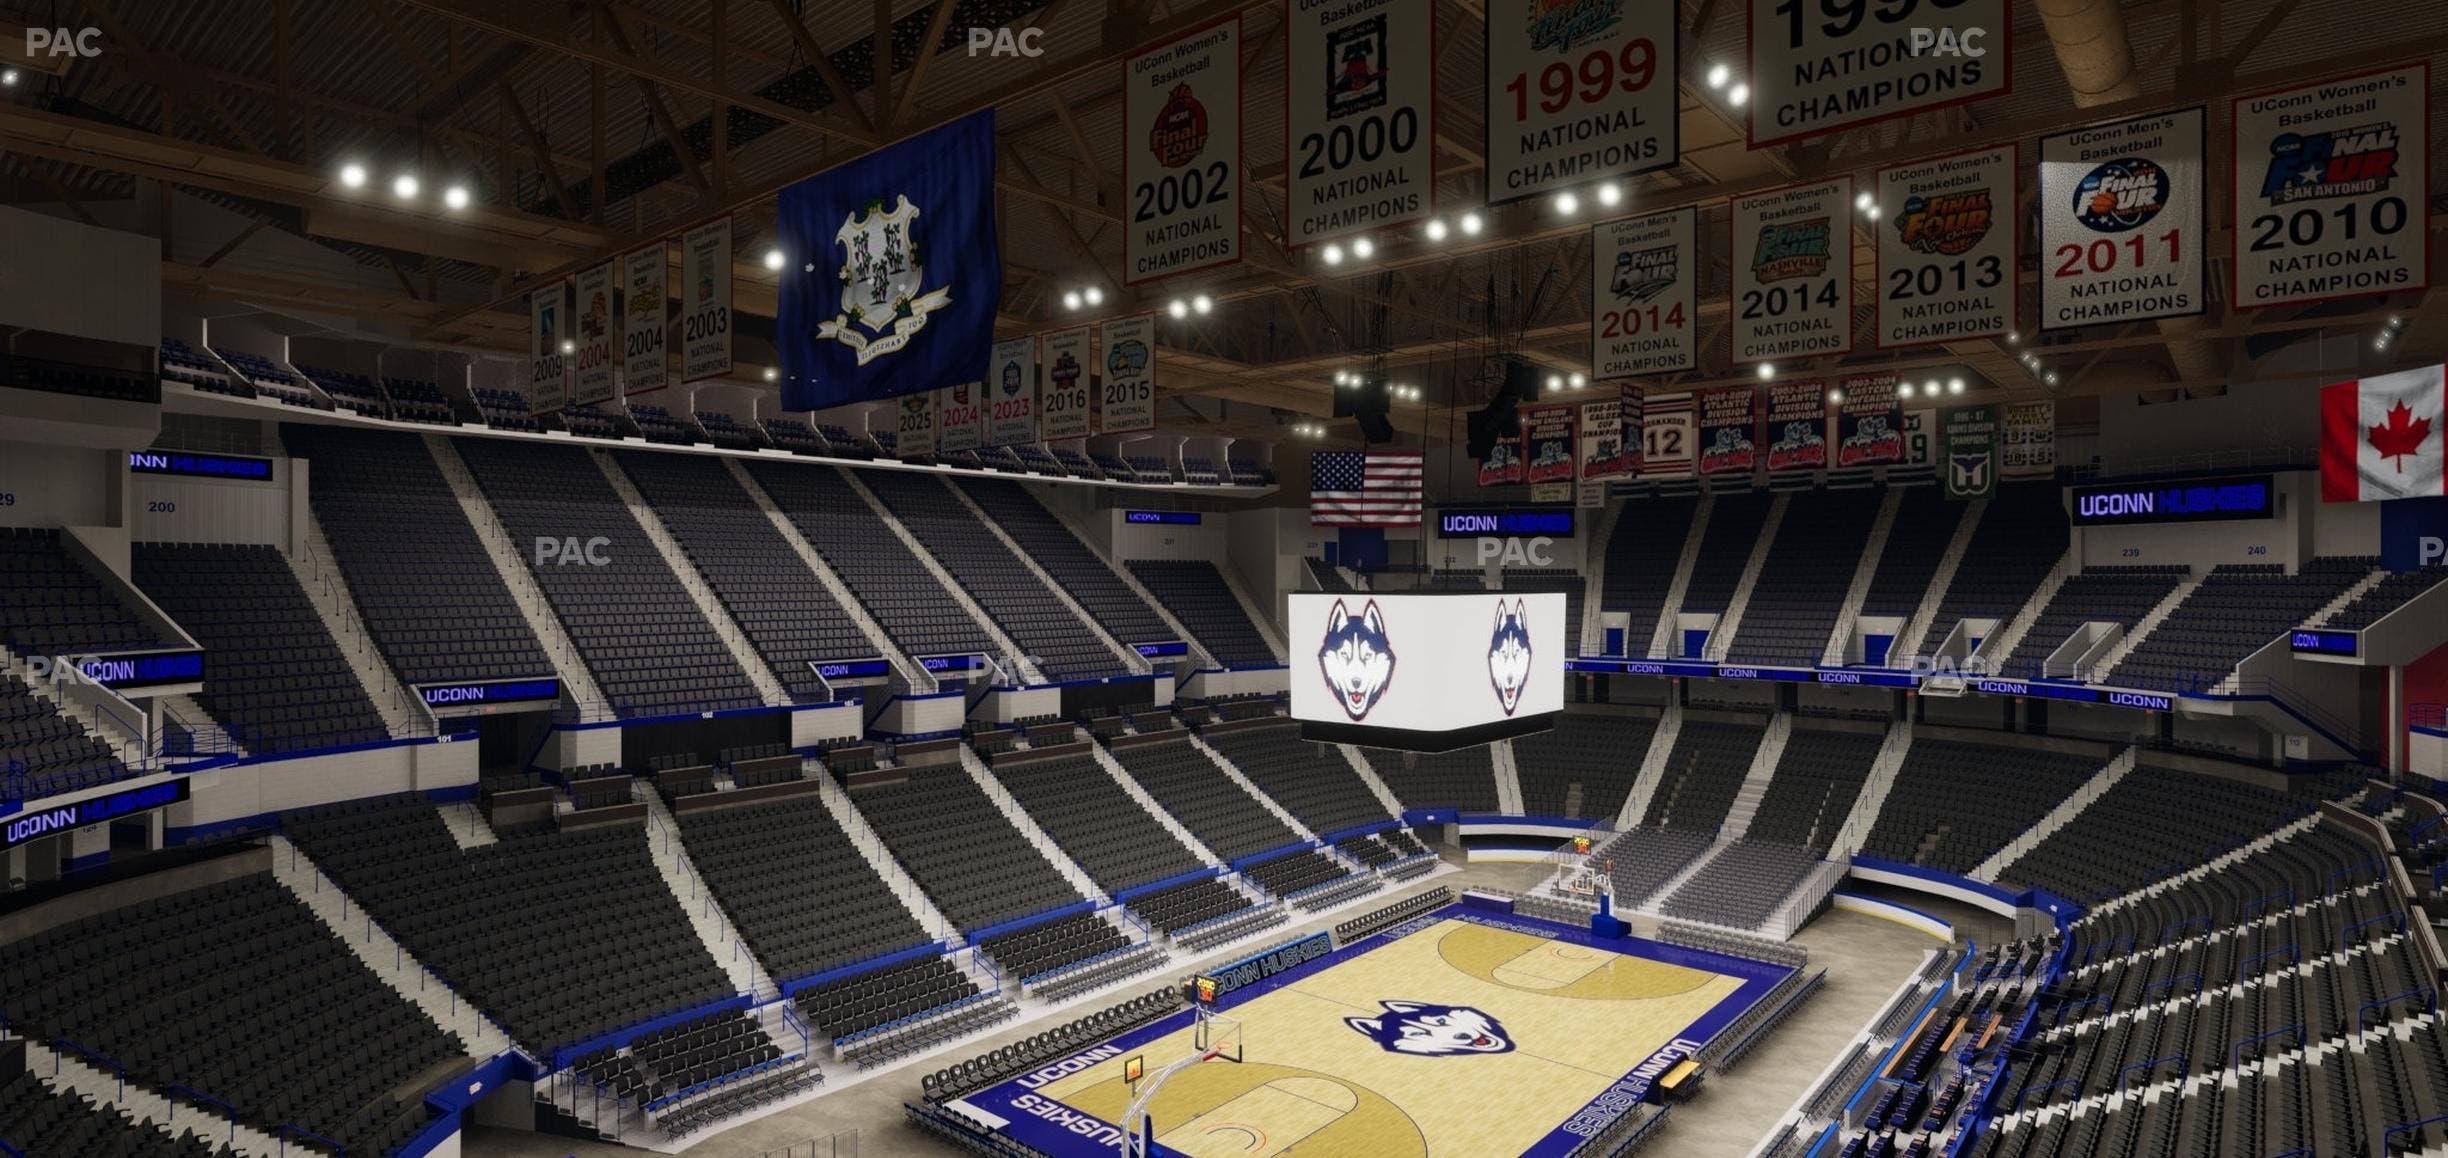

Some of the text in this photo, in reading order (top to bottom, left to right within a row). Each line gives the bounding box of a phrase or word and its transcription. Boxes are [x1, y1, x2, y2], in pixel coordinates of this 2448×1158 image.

[1136, 31, 1228, 73] UConn Women's
[1151, 55, 1210, 87] Basketball
[1507, 37, 1656, 121] 1999
[1777, 60, 1981, 126] CHAMPIONS
[2251, 75, 2407, 114] UConn Women's
[2279, 98, 2377, 127] Basketball
[1521, 106, 1645, 154] NATIONAL
[2069, 118, 2174, 147] UConn Men's
[1299, 106, 1417, 179] 2000
[2080, 136, 2162, 161] Basketball
[1508, 137, 1658, 189] CHAMPIONS
[1889, 152, 2002, 182] UConn Women's
[1135, 161, 1228, 222] 2002
[1313, 167, 1409, 205] NATIONAL
[1910, 172, 1980, 194] Basketball
[2100, 172, 2157, 195] FINAL
[2283, 179, 2376, 200] SAN ANTONIO
[1742, 184, 1840, 210] UConn Women's
[1303, 193, 1418, 235] CHAMPIONS
[1760, 202, 1821, 221] Basketball
[1146, 214, 1222, 246] NATIONAL
[1611, 214, 1677, 234] UConn Men's
[2250, 197, 2407, 252] 2010
[1618, 228, 1670, 245] Basketball
[1138, 238, 1230, 274] CHAMPIONS
[2055, 228, 2179, 278] 2011
[2269, 245, 2396, 275] NATIONAL
[1759, 256, 1824, 276] NASHVILLE
[1889, 255, 2002, 301] 2013
[2070, 273, 2178, 299] NATIONAL
[2256, 267, 2409, 299] CHAMPIONS
[1742, 279, 1840, 319] 2014
[1902, 296, 1995, 320] NATIONAL
[2059, 294, 2188, 321] CHAMPIONS
[686, 307, 727, 342] 2003
[1602, 302, 1686, 338] 2014
[1753, 318, 1833, 338] NATIONAL
[1892, 315, 2004, 341] CHAMPIONS
[627, 328, 663, 358] 2004
[690, 342, 724, 358] NATIONAL
[1611, 337, 1680, 355] NATIONAL
[1744, 335, 1841, 358] CHAMPIONS
[578, 342, 609, 370] 2004
[1604, 353, 1686, 373] CHAMPIONS
[534, 355, 562, 382] 2009
[1046, 389, 1086, 412] 2016
[1106, 381, 1150, 404] 2015
[1773, 393, 1820, 404] ATLANTIC
[1849, 385, 1893, 397] EASTERN
[944, 405, 978, 427] 2024
[994, 398, 1030, 420] 2023
[1110, 405, 1146, 416] NATIONAL
[1704, 398, 1751, 411] ATLANTIC
[1707, 408, 1747, 419] DIVISION
[1769, 409, 1824, 422] CHAMPIONS
[1775, 402, 1818, 413] DIVISION
[1843, 401, 1897, 415] CHAMPIONS
[900, 412, 932, 432] 2025
[1107, 416, 1150, 429] CHAMPIONS
[1700, 415, 1754, 428] CHAMPIONS
[1646, 430, 1682, 457] 12
[148, 501, 176, 513] 200
[2080, 481, 2267, 517] UCONN HUSKIES
[1127, 511, 1161, 522] UCONN
[1443, 514, 1498, 533] UCONN
[2122, 547, 2140, 558] 239
[2247, 545, 2267, 556] 240
[2291, 632, 2320, 649] UCONN
[1626, 663, 1664, 675] UCONN
[1719, 667, 1758, 679] UCONN
[1818, 672, 1860, 685] UCONN
[426, 686, 485, 704] UCONN
[1979, 680, 2028, 696] UCONN
[2110, 692, 2170, 711] UCONN
[437, 734, 453, 743] 101
[7, 806, 77, 844] UCONN
[1262, 937, 1333, 976] HUSKIES
[1016, 1044, 1123, 1089] UCONN
[1562, 1038, 1702, 1137] UCONN HUSKIES
